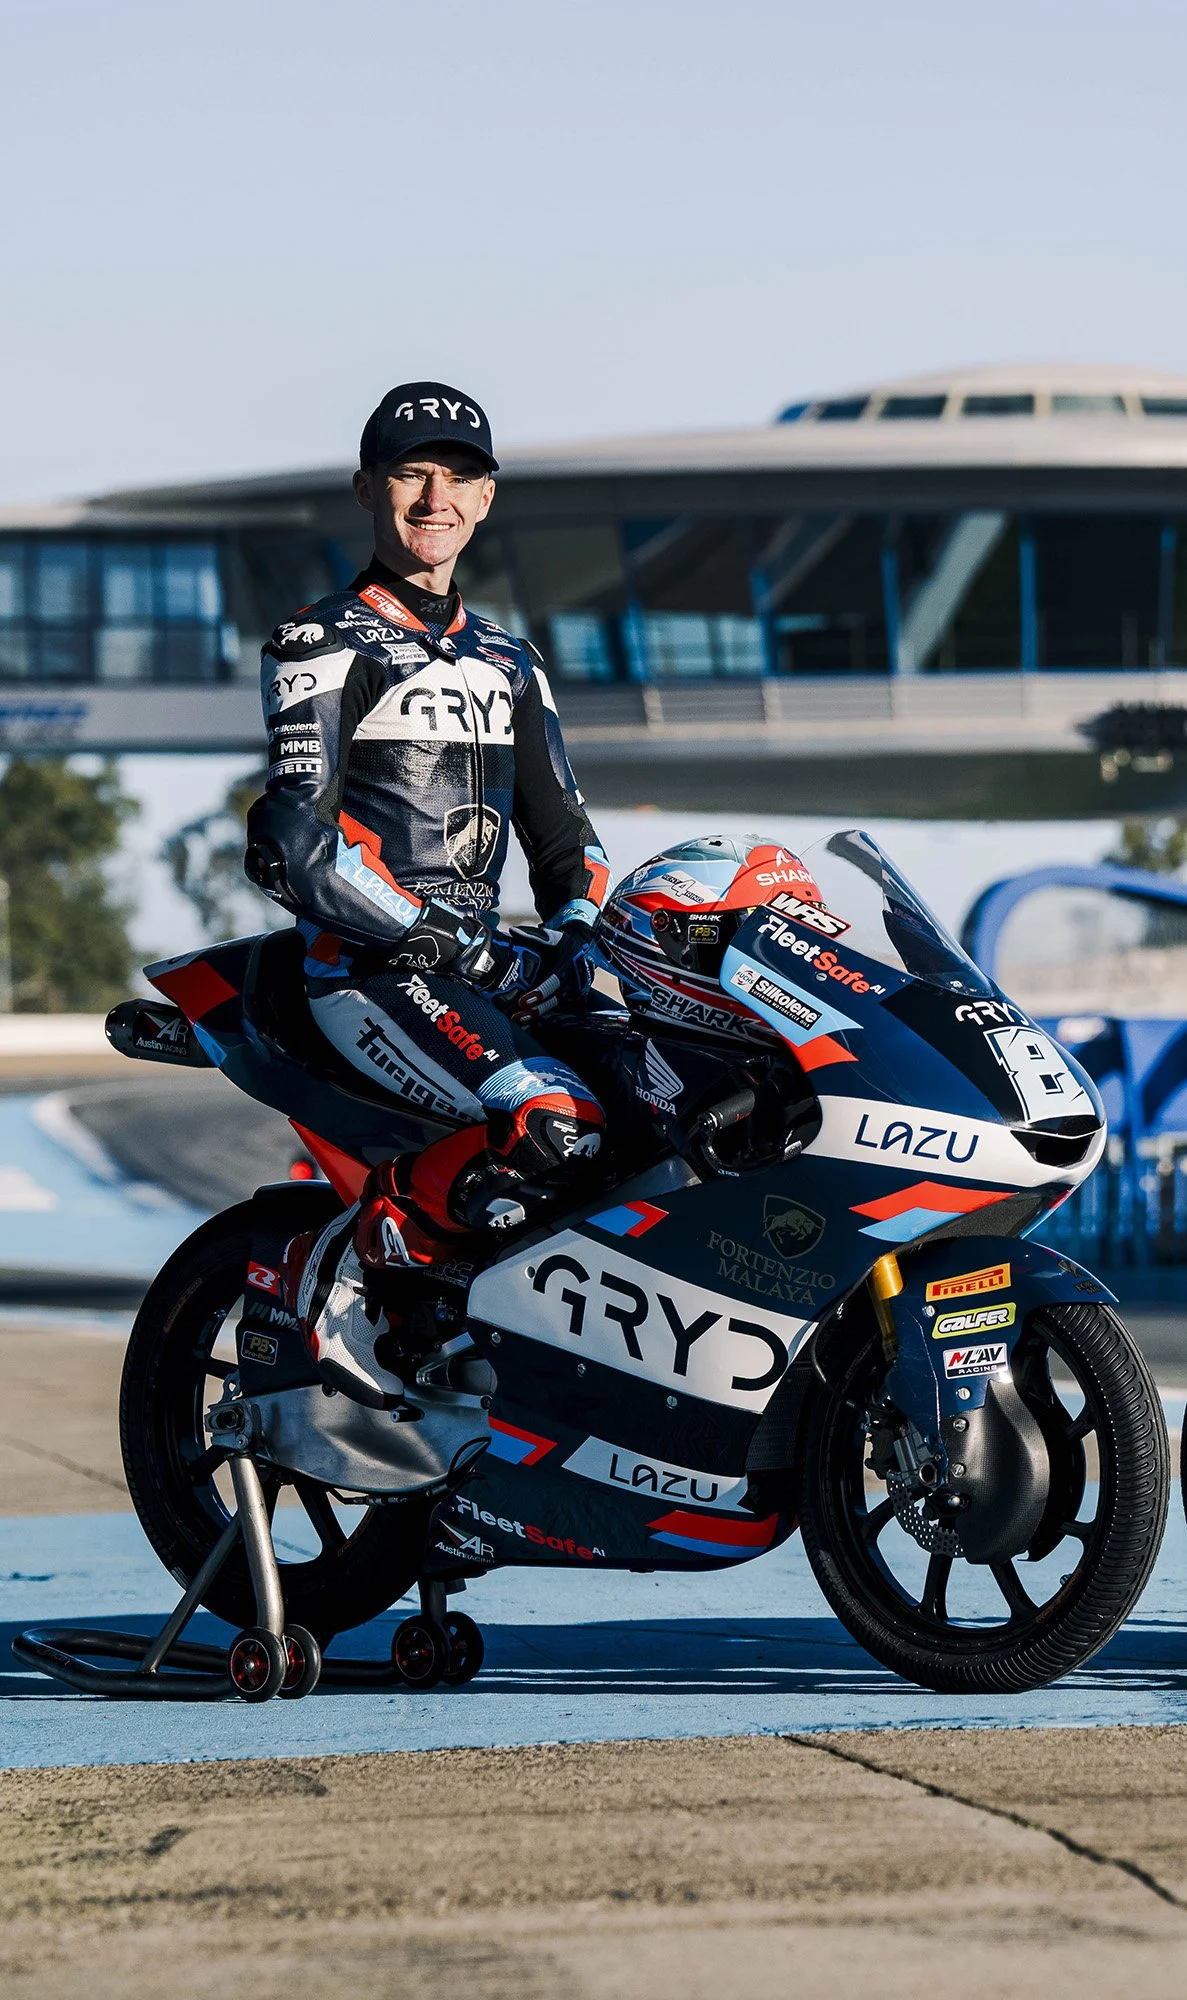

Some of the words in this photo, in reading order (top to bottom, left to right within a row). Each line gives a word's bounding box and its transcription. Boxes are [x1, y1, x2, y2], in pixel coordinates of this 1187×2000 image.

[267, 673, 317, 704] RYD
[280, 740, 321, 755] MMB
[689, 914, 723, 922] SHARK
[771, 893, 847, 934] WRS
[755, 979, 819, 1023] Silkolene
[983, 1026, 1096, 1123] 8
[636, 1086, 677, 1115] HONDA
[854, 1114, 979, 1163] LAZU
[707, 1230, 836, 1290] FORTENZIO
[717, 1257, 817, 1306] MALAYA
[932, 1268, 1004, 1297] PIRELLI
[938, 1308, 1010, 1333] GALFER
[958, 1365, 998, 1375] RACING
[609, 1454, 718, 1503] LAZU
